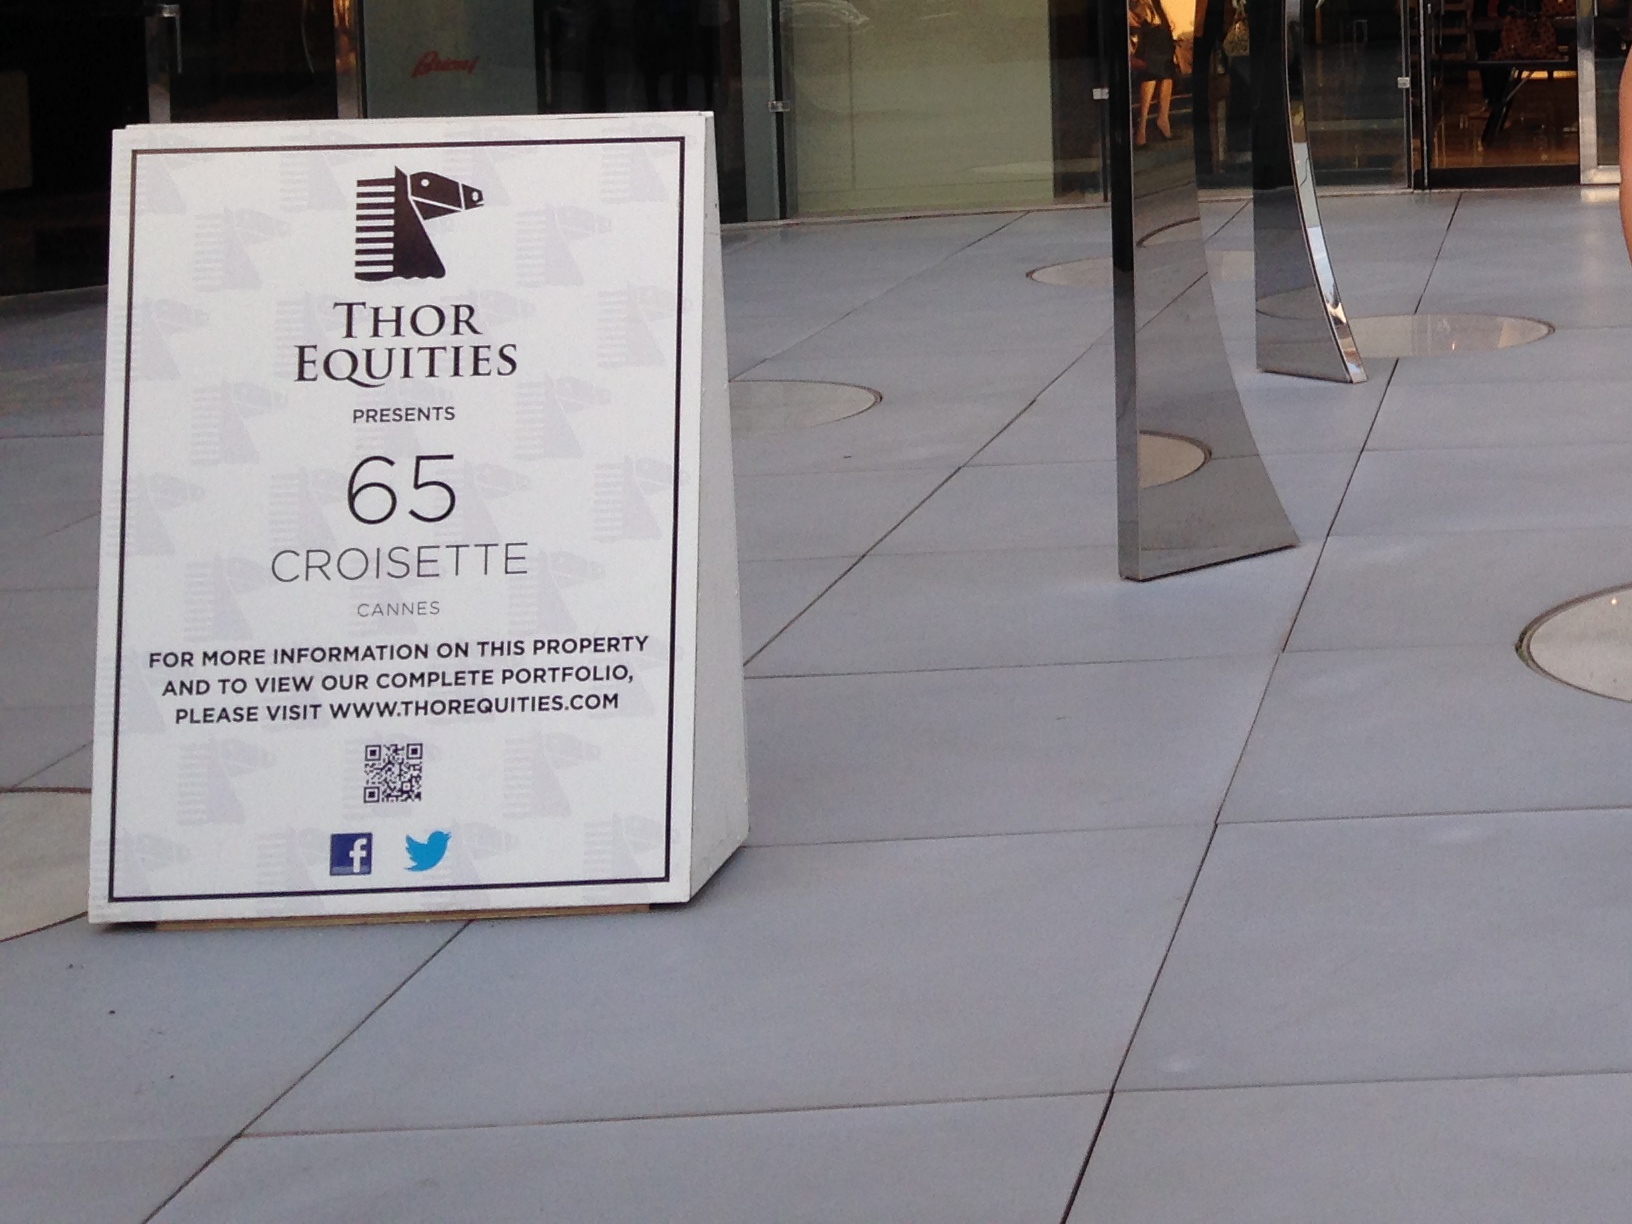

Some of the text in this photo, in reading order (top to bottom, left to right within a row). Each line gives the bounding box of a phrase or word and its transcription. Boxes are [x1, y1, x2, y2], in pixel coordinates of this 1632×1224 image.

[332, 301, 483, 339] THOR
[293, 343, 518, 389] EQUITIES
[352, 406, 456, 424] PRESENTS
[347, 454, 457, 525] 65
[271, 542, 528, 583] CROISETTE
[357, 601, 441, 618] CANNES
[148, 635, 650, 669] FOR MORE INFORMATION ON THIS PROPERTY
[162, 664, 635, 697] AND TO VIEW OUR COMPLETE PORTFOLIO,
[175, 693, 619, 725] PLEASE VISIT WWW.THOREQUITIES.COM
